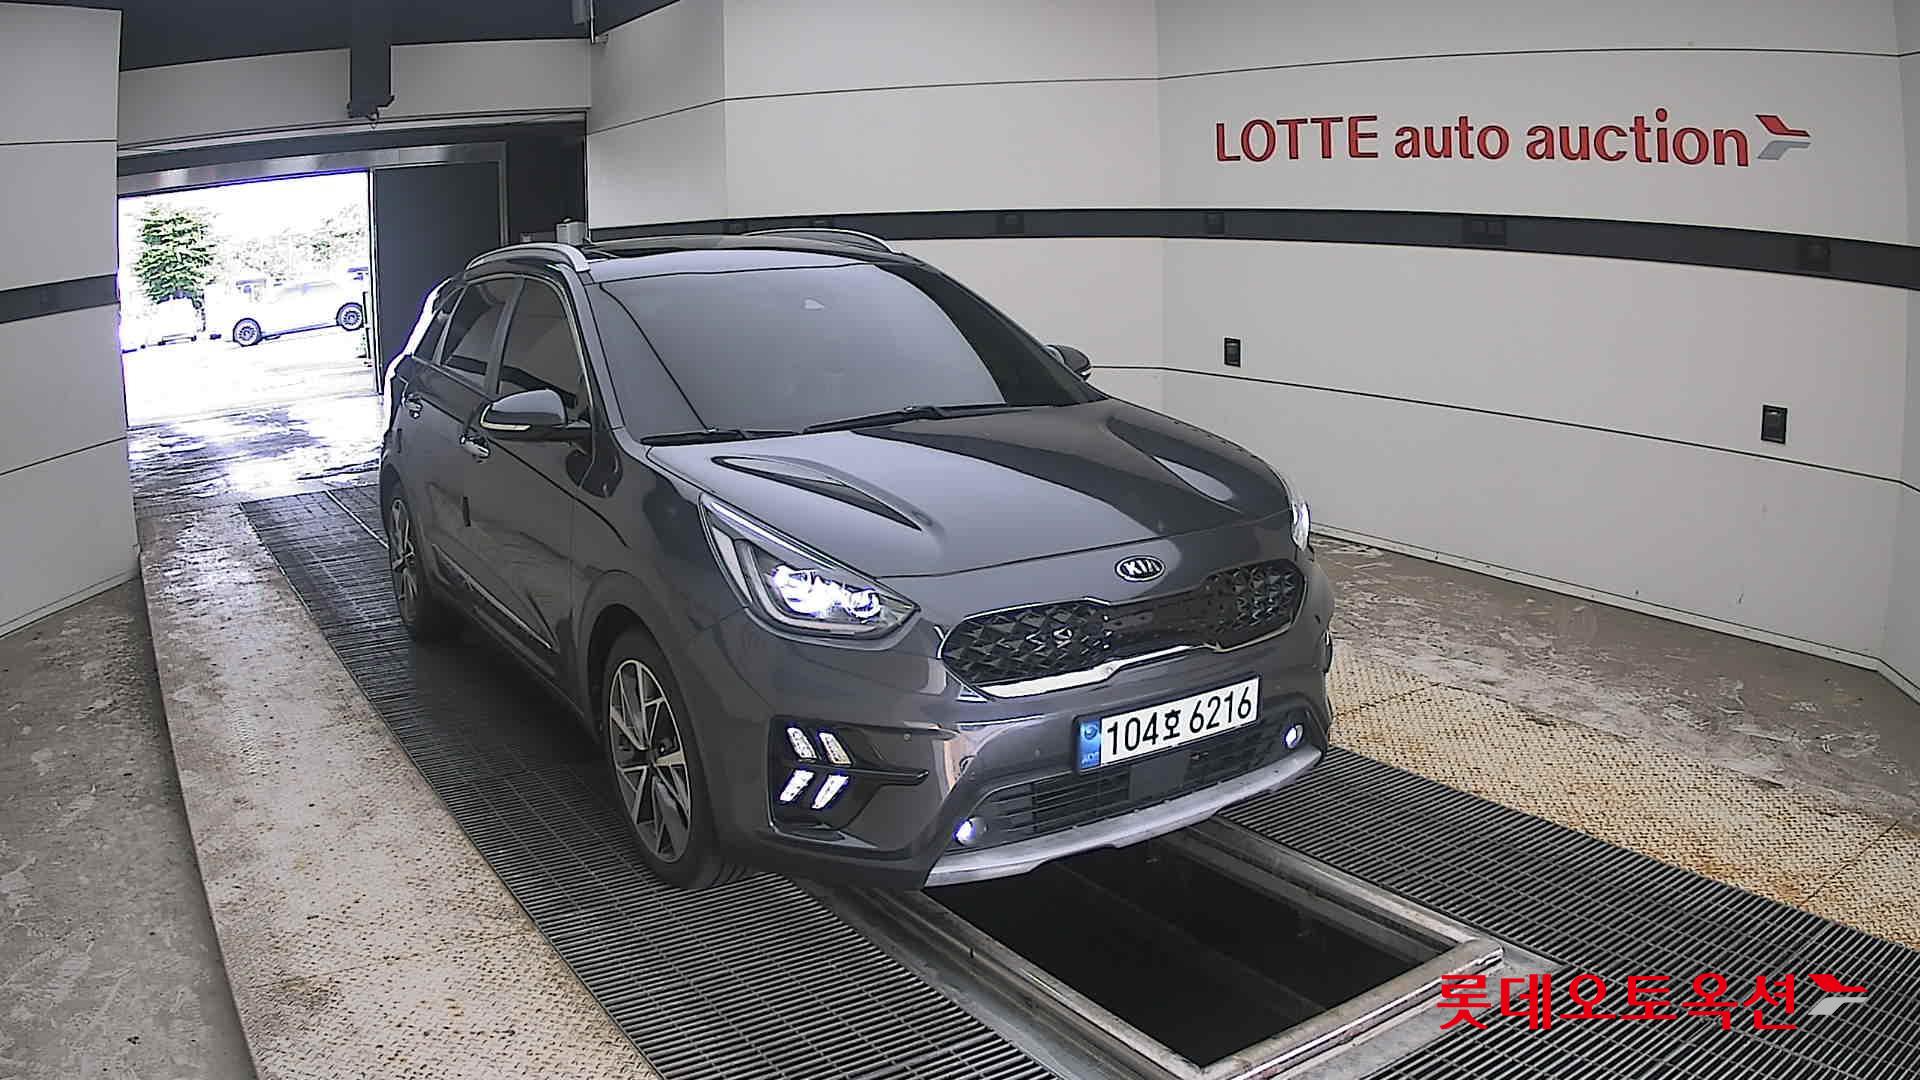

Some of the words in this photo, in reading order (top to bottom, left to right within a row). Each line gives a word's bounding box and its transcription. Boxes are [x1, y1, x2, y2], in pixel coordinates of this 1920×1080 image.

[1215, 115, 1379, 162] LOTTE
[1393, 115, 1511, 160] auto
[1526, 108, 1750, 167] auction
[1122, 559, 1161, 576] KIA
[1106, 709, 1182, 756] 104호
[1188, 686, 1252, 734] 6216
